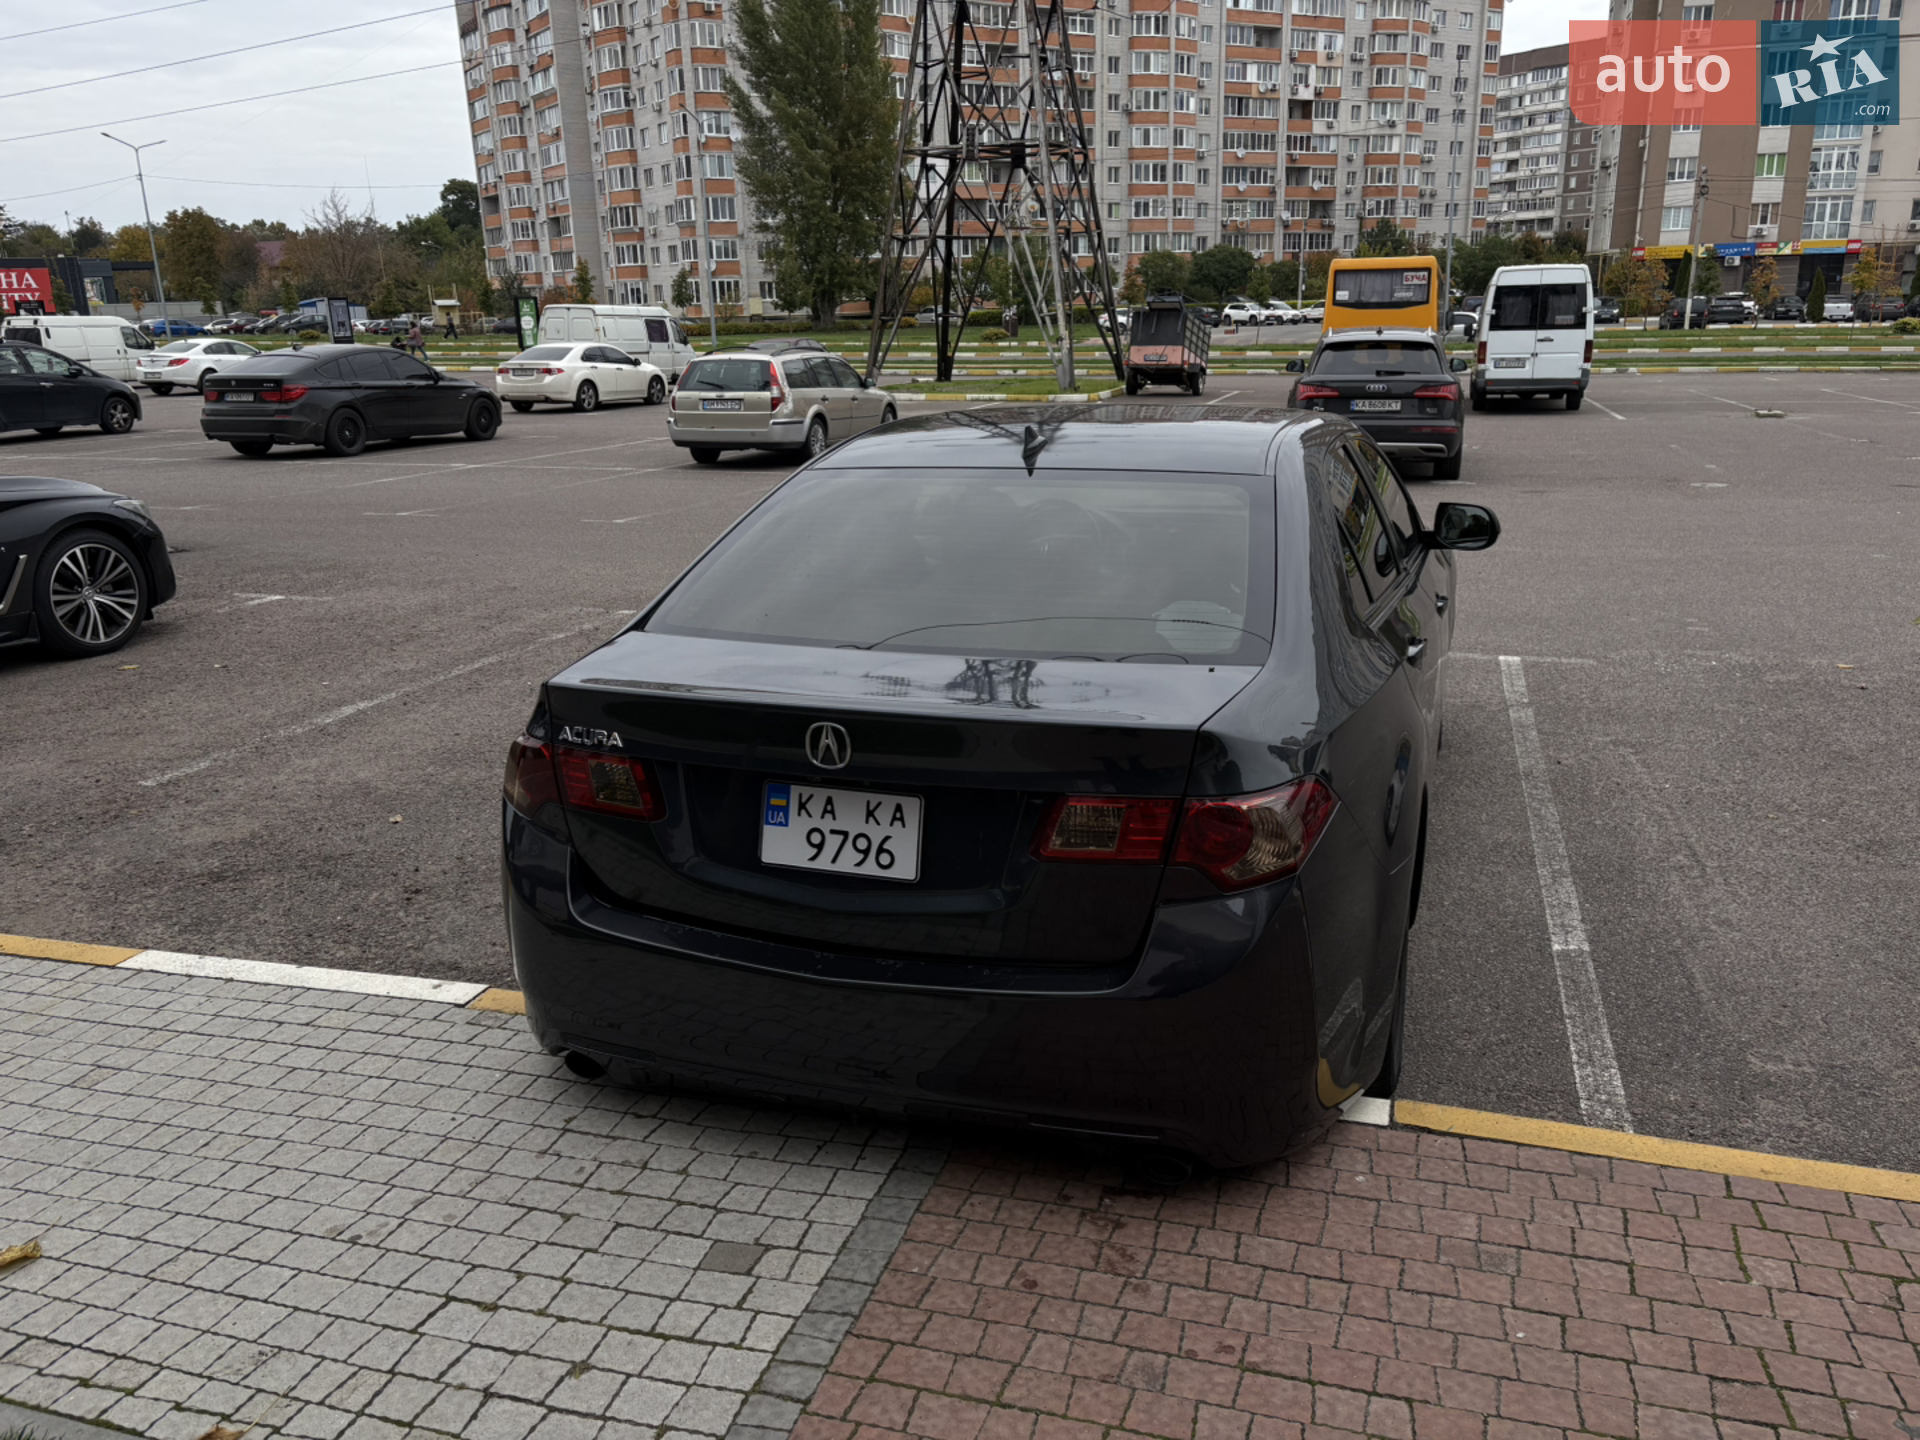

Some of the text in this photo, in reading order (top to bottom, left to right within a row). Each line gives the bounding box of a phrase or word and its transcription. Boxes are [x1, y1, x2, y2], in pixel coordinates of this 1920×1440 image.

[1404, 273, 1427, 283] БУЧА
[558, 725, 624, 748] ACURA
[768, 810, 786, 824] UA
[797, 792, 906, 829] KA KA
[805, 826, 896, 871] 9796
